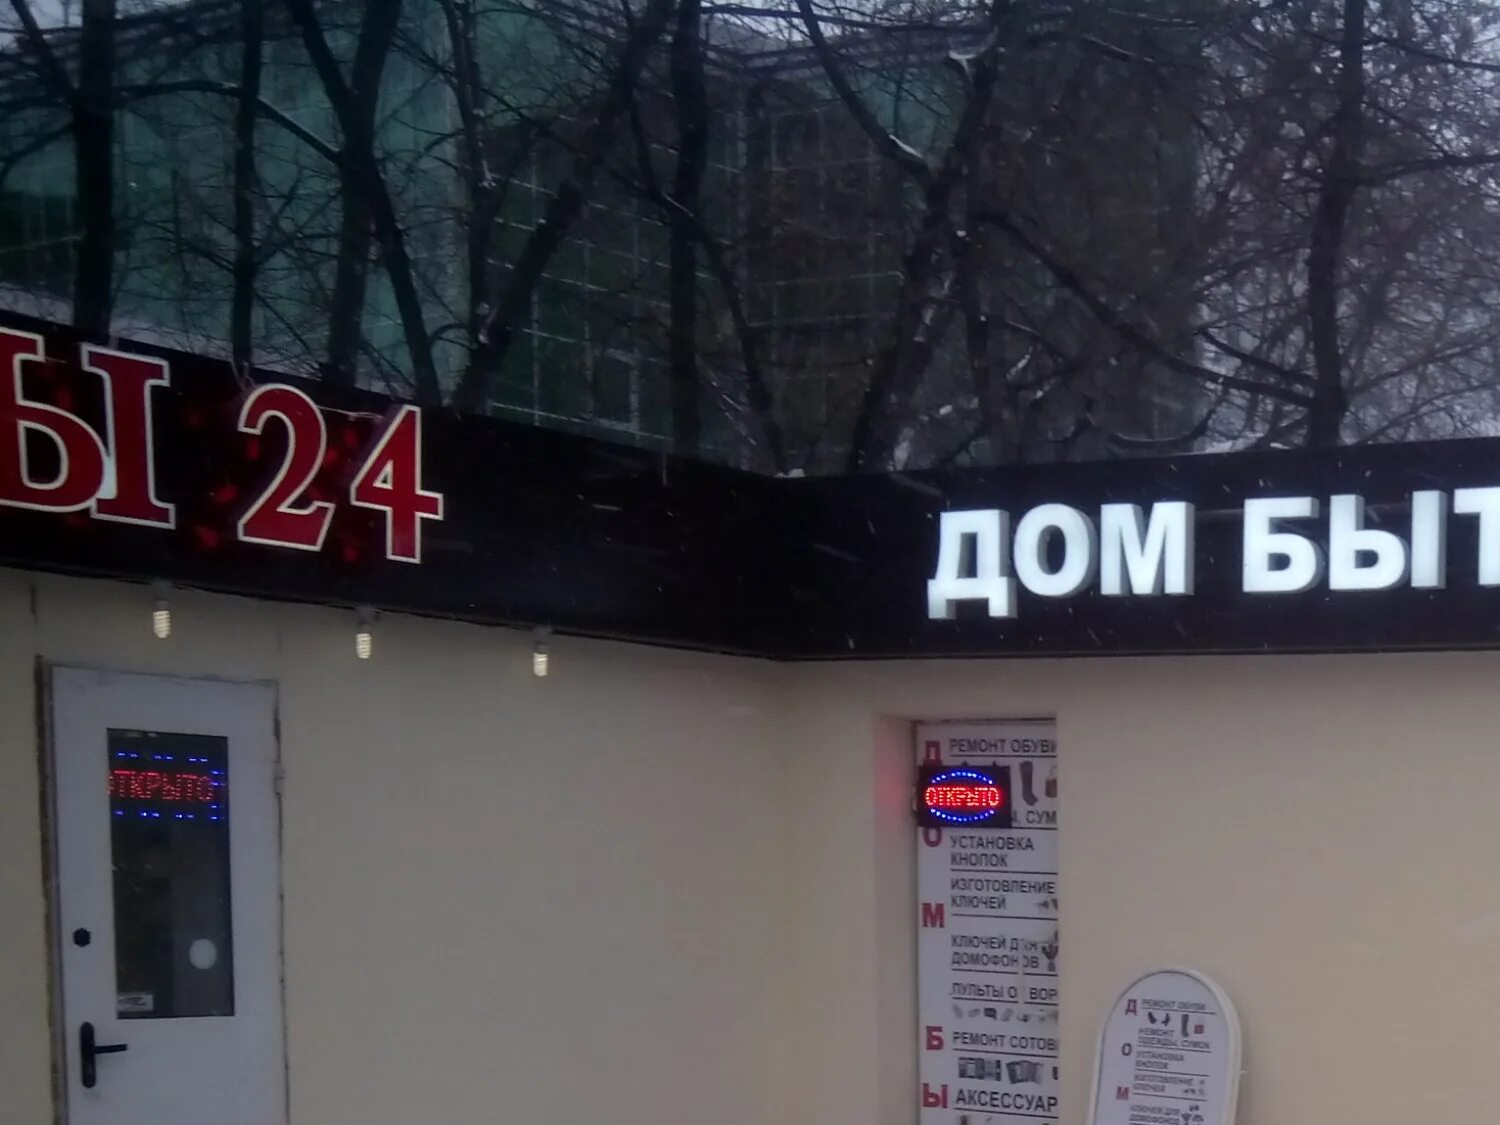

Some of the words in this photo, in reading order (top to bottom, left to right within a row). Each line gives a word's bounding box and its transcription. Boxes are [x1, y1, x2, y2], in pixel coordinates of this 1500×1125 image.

[237, 383, 444, 563] 24
[927, 501, 1196, 619] ДОМ
[950, 738, 1006, 753] РЕМОНТ
[926, 787, 999, 806] ОТКРЫТО
[950, 835, 1035, 851] УСТАНОВКА
[950, 852, 1008, 867] КНОПОК
[951, 878, 1057, 894] ИЗГОТОВЛЕНИЕ
[952, 982, 1004, 998] ПУЛЬТЫ
[952, 1031, 1006, 1048] РЕМОНТ
